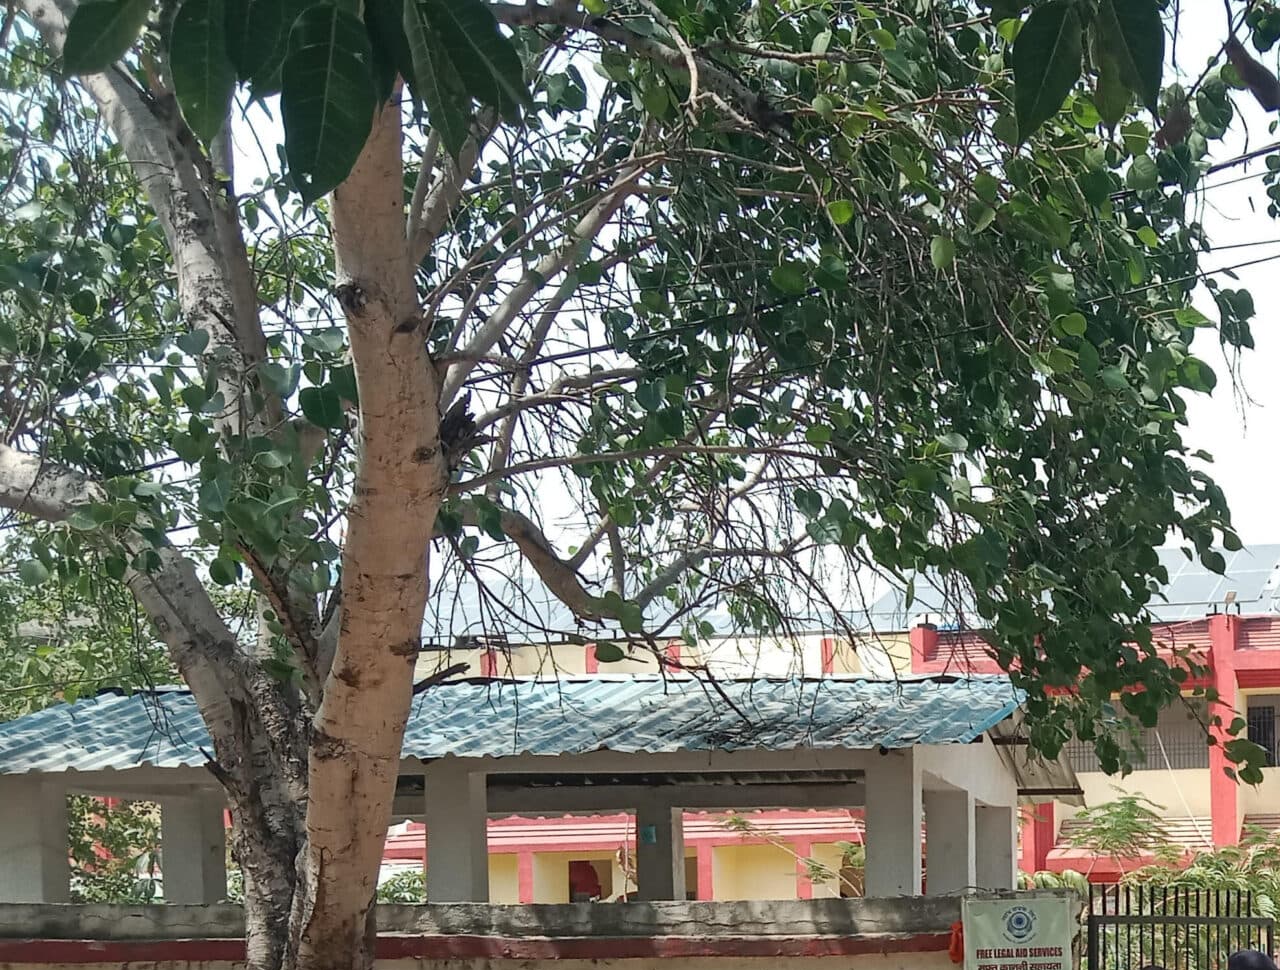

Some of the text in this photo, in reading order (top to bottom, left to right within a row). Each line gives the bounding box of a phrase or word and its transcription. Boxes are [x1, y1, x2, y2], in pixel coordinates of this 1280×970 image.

[976, 947, 1063, 959] FREE LEGAL AID SERVICES
[1029, 962, 1062, 970] सहायता
